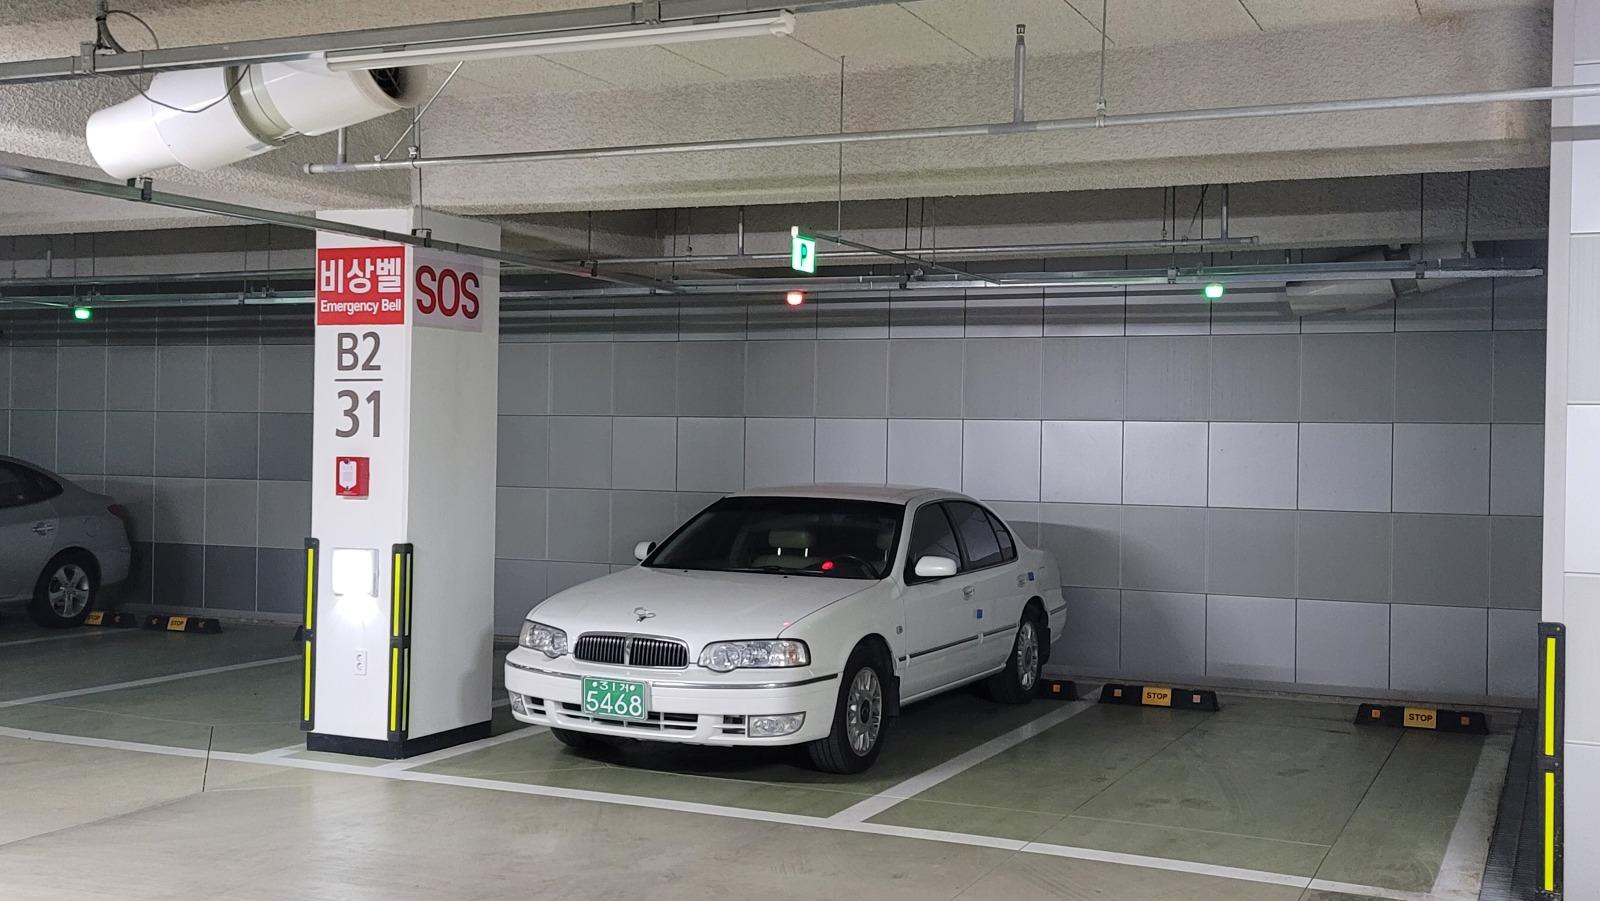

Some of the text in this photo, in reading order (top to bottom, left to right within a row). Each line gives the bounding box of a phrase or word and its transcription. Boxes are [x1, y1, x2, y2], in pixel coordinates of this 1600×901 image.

[320, 257, 401, 294] 비상벨
[320, 298, 401, 316] Emergency Bell
[415, 265, 480, 320] SOS
[337, 331, 382, 371] B2
[335, 389, 381, 438] 31
[587, 691, 642, 716] 5468
[1146, 691, 1168, 700] STOP
[1408, 713, 1433, 722] STOP
